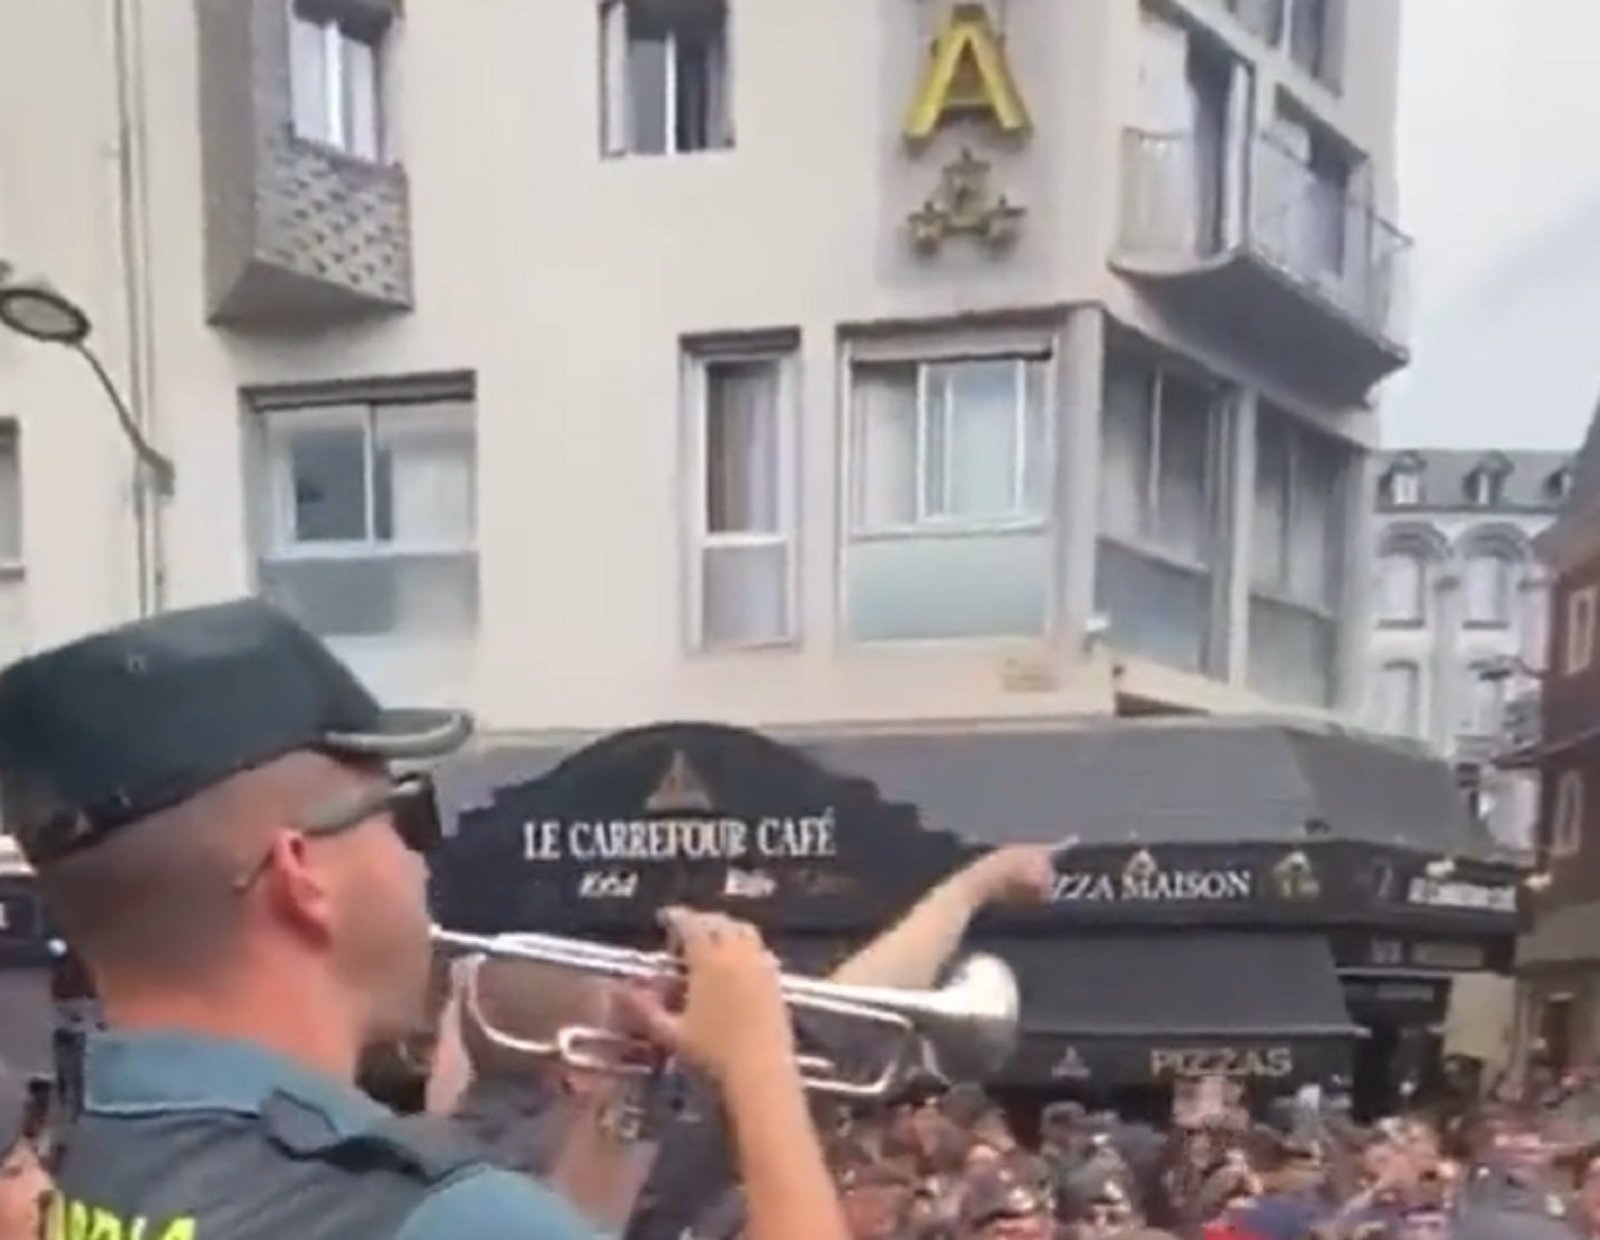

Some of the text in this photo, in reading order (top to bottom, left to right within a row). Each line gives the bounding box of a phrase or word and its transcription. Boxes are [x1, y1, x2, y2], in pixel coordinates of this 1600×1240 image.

[902, 4, 1033, 145] A
[524, 805, 837, 861] LE CARREFOUR CAFÉ
[1053, 868, 1250, 901] ZZA MAISON
[1151, 1047, 1293, 1077] PIZZAS
